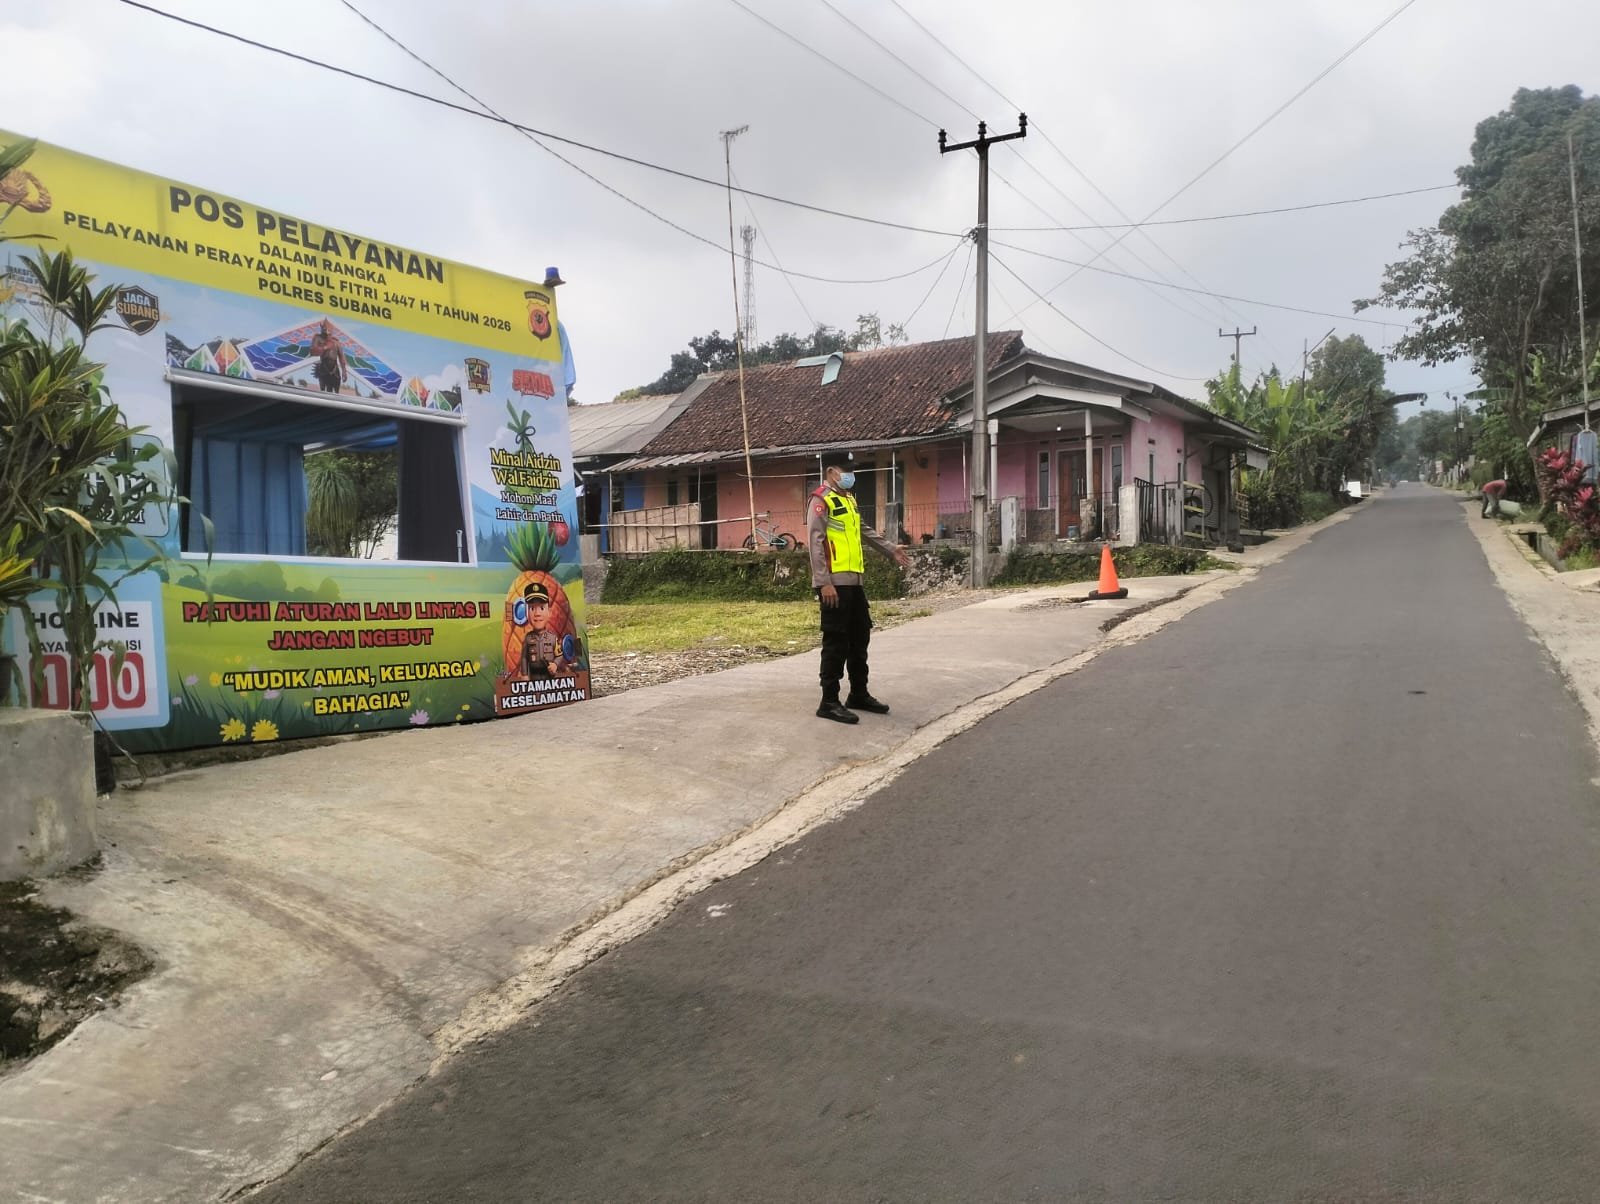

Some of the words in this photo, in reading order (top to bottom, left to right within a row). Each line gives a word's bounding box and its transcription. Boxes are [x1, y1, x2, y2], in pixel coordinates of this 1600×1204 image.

[169, 185, 244, 229] POS
[256, 210, 444, 284] PELAYANAN
[63, 210, 189, 254] PELAYANAN
[195, 243, 291, 279] PERAYAAN
[297, 268, 335, 290] IDUL
[339, 279, 378, 301] FITRI
[383, 290, 416, 309] 1447
[420, 299, 430, 313] H
[433, 303, 480, 325] TAHUN
[482, 315, 512, 333] 2026
[259, 242, 318, 269] DALAM
[322, 258, 387, 286] RANGKA
[123, 292, 150, 306] JAGA
[258, 277, 324, 305] POLRES
[329, 295, 393, 321] SUBANG
[116, 302, 159, 321] SUBANG
[490, 448, 524, 468] Minal
[526, 452, 561, 472] Aidzin
[491, 467, 519, 485] Wal
[519, 471, 561, 490] Faidzin
[501, 491, 534, 504] Mohon
[535, 494, 557, 506] Maaf
[496, 508, 521, 520] Lahir
[522, 510, 540, 521] dan
[540, 511, 565, 523] Batin
[183, 601, 271, 623] PATUHI
[275, 601, 361, 622] ATURAN
[364, 601, 412, 621] LALU
[415, 601, 477, 620] LINTAS
[268, 630, 356, 650] JANGAN
[359, 628, 434, 649] NGEBUT
[223, 668, 311, 692] “MUDIK
[312, 665, 377, 689] AMAN,
[379, 660, 477, 684] KELUARGA
[511, 677, 576, 695] UTAMAKAN
[313, 691, 410, 717] BAHAGIA”
[501, 689, 586, 710] KESELAMATAN
